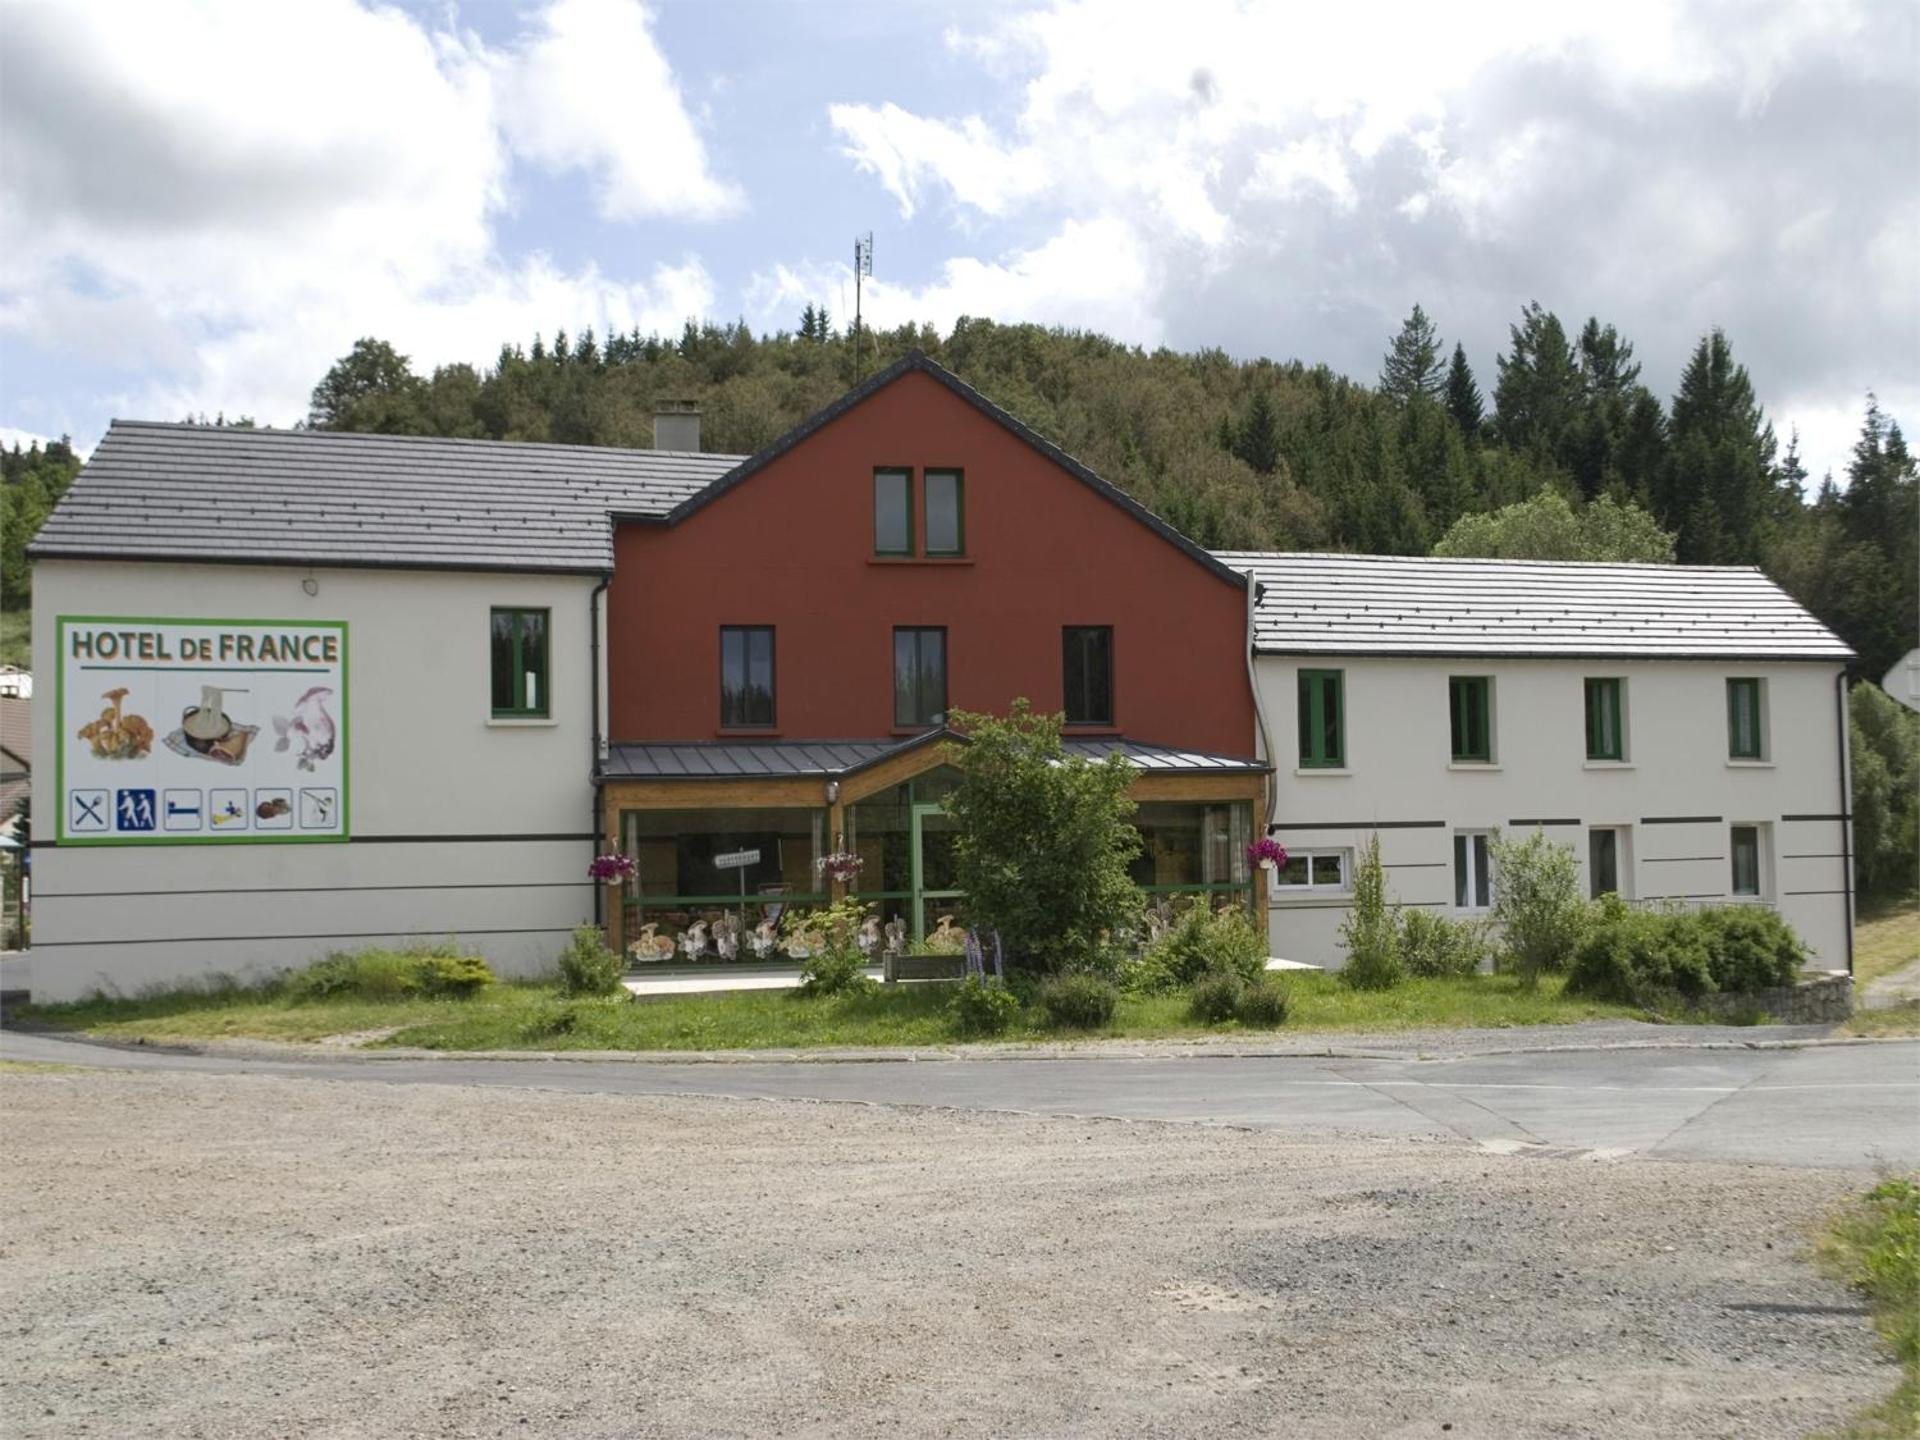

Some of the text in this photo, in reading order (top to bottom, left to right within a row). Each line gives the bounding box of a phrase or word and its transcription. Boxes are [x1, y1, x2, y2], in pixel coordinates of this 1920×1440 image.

[72, 631, 338, 663] HOTEL DE FRANCE
